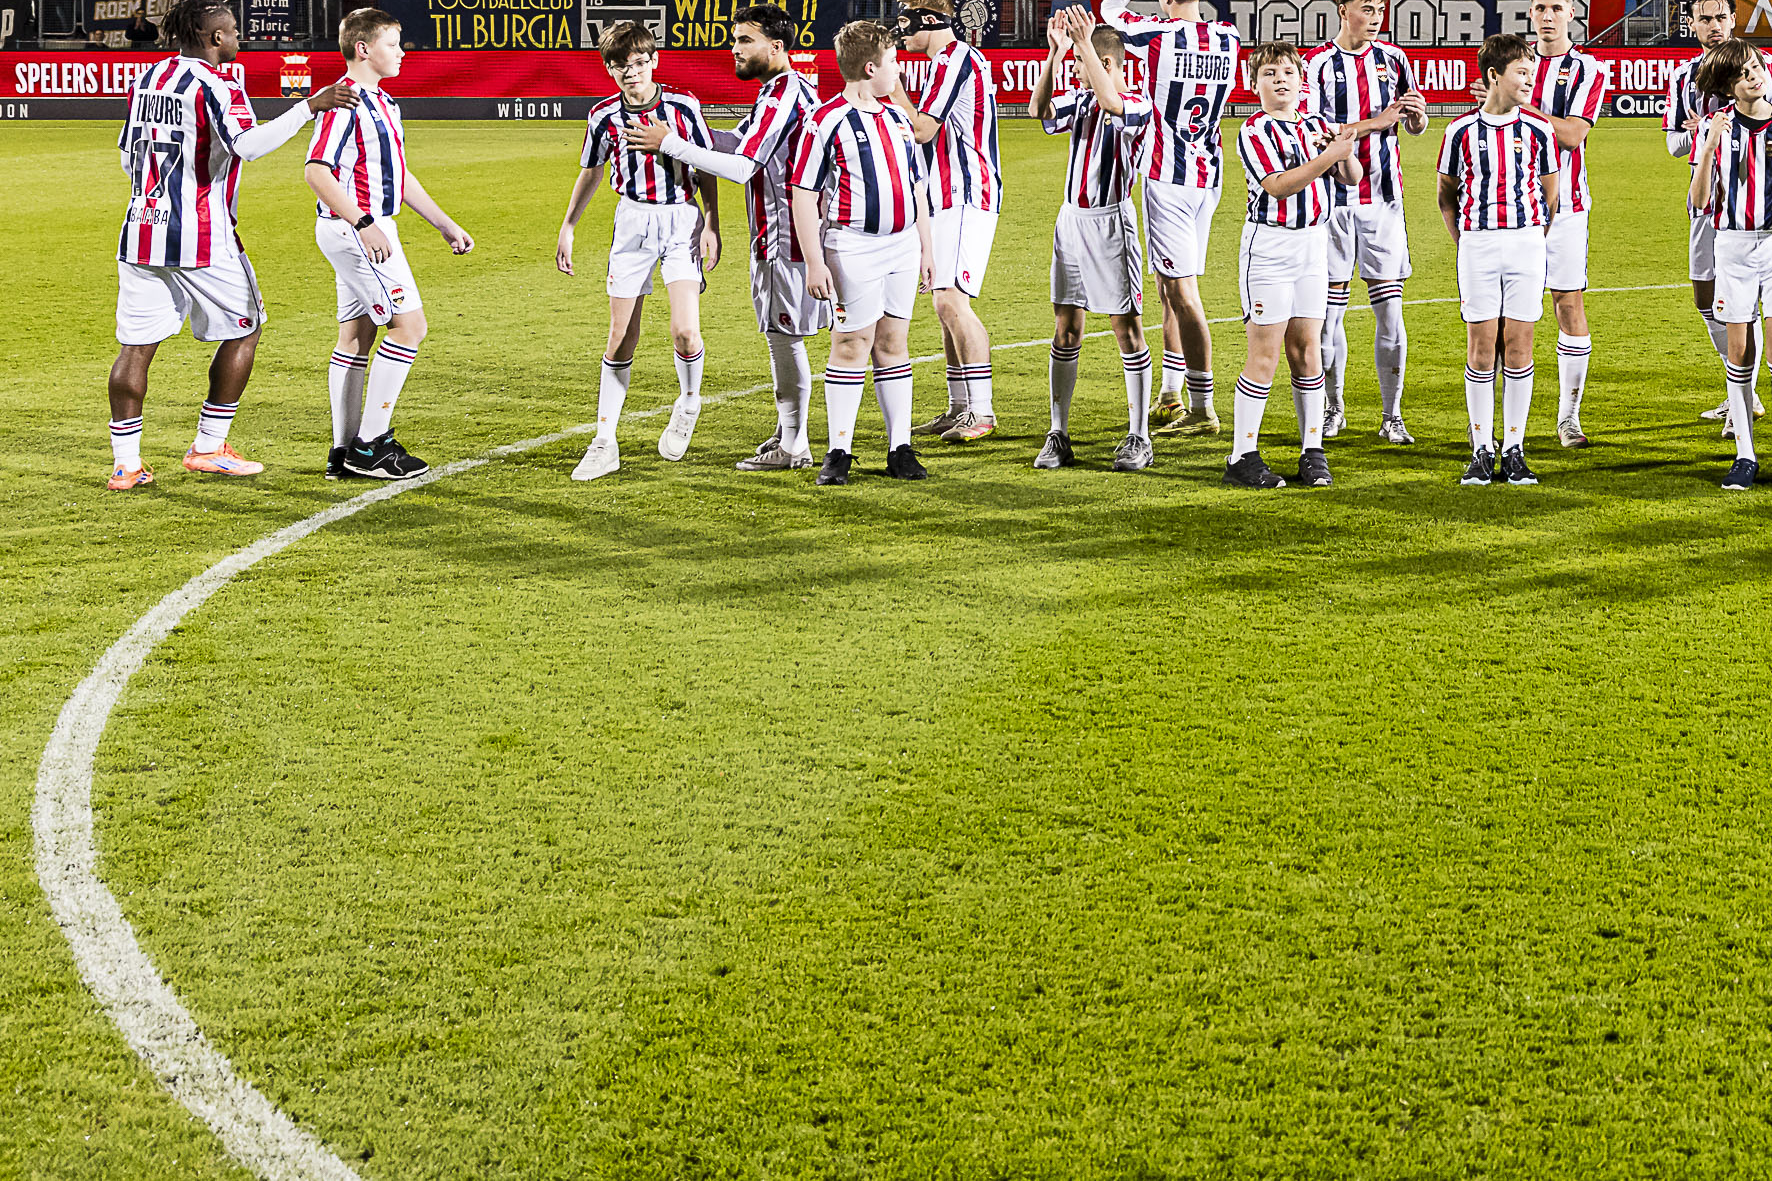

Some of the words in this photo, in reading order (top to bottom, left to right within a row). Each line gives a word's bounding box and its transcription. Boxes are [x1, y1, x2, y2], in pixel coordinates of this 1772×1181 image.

[431, 13, 573, 49] TILBURGIA
[16, 62, 99, 94] SPELERS
[1174, 53, 1230, 81] TILBURG
[1180, 96, 1210, 143] 3
[133, 138, 182, 198] 17
